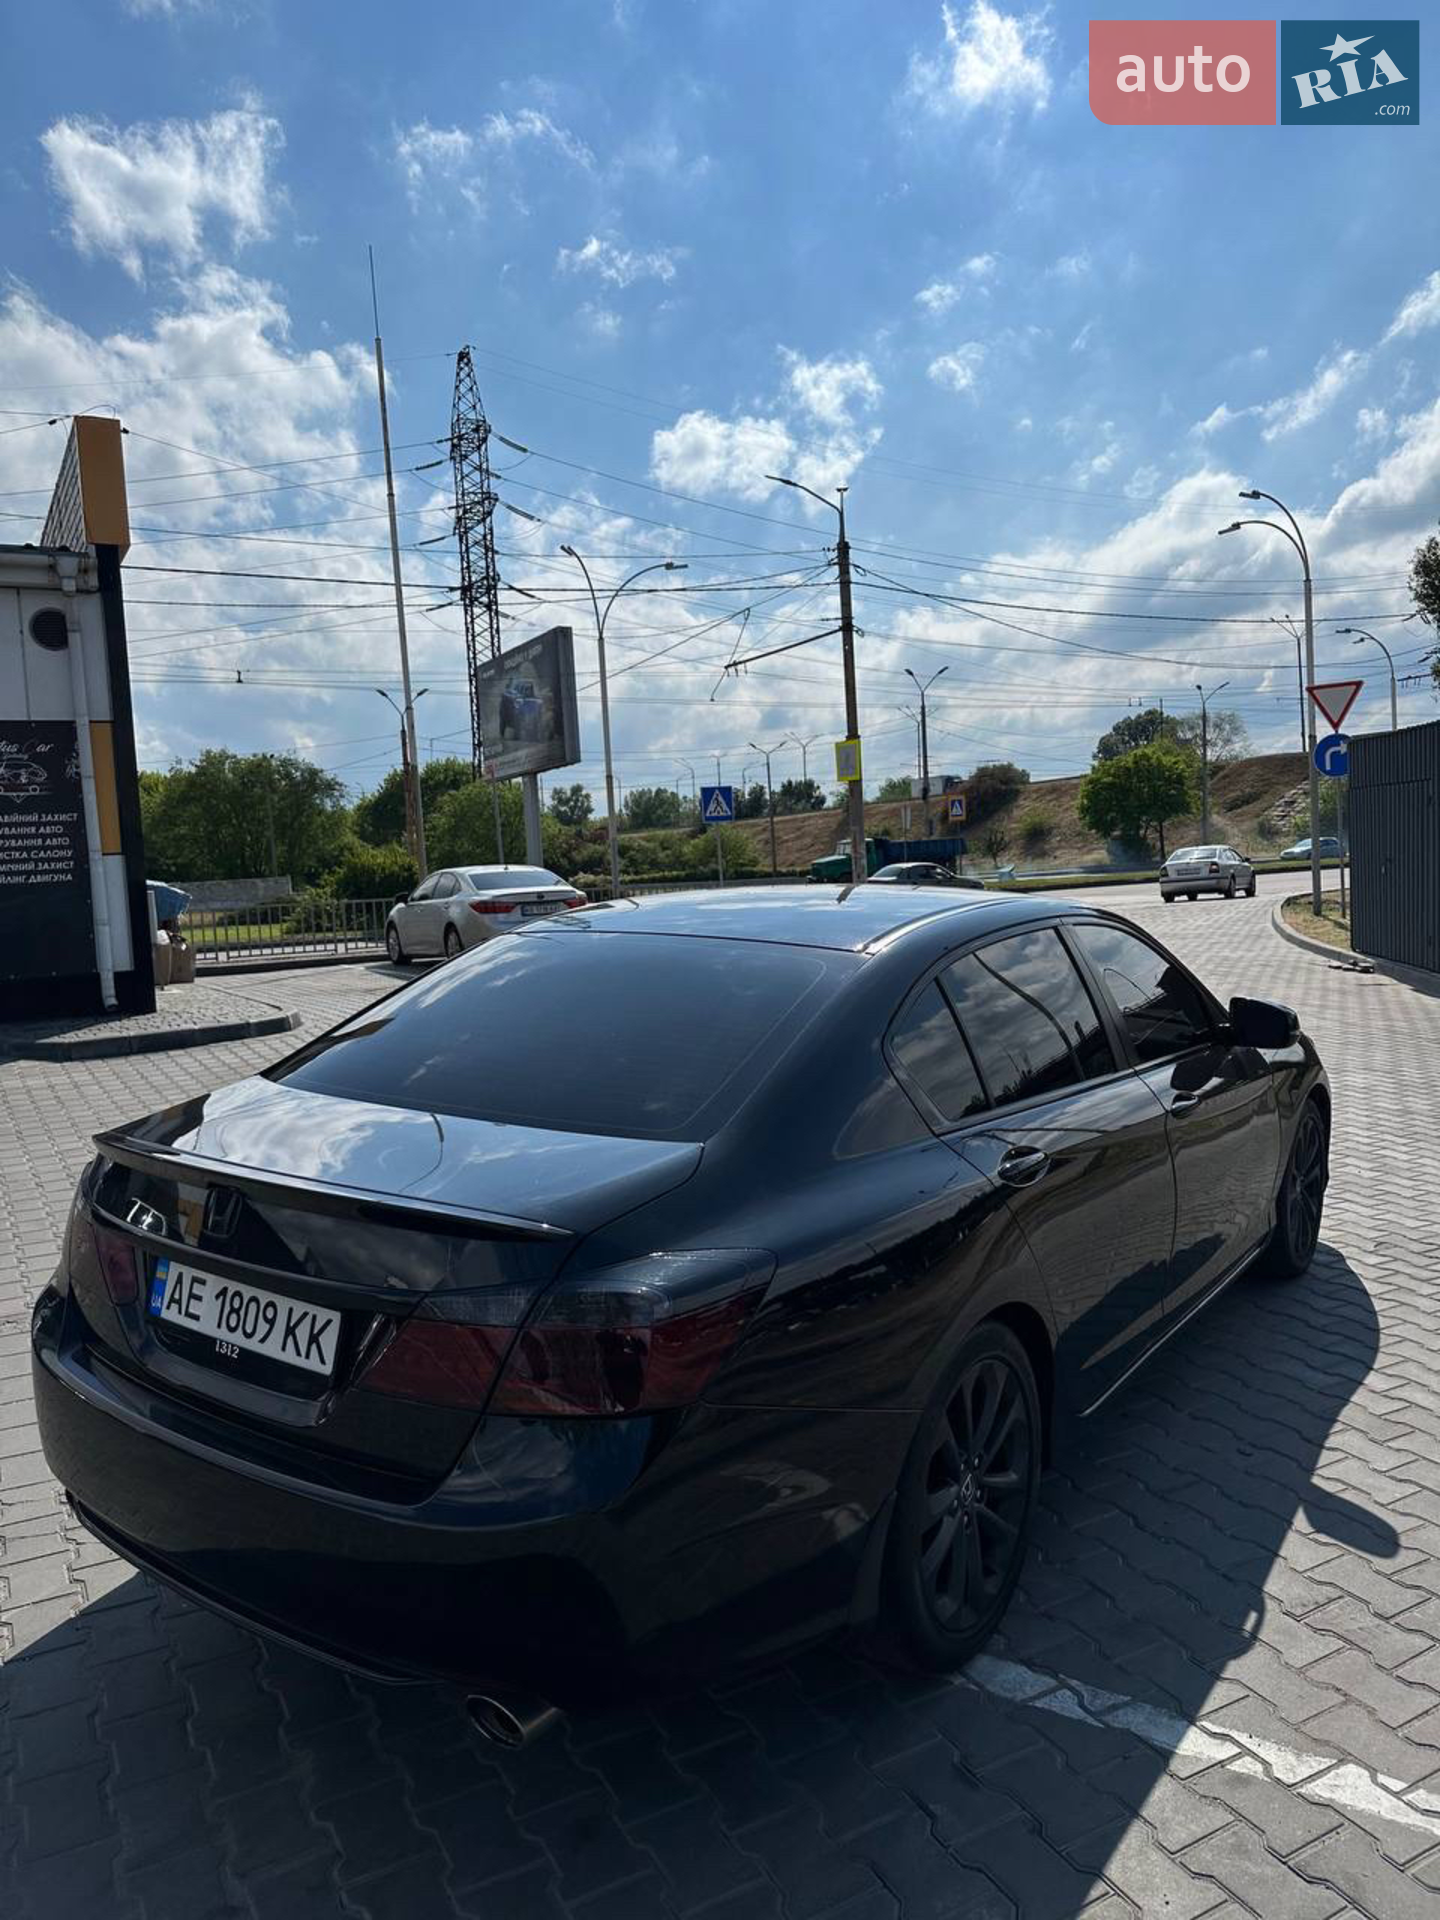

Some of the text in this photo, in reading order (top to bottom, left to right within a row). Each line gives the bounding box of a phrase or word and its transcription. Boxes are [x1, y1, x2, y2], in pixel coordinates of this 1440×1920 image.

[41, 813, 78, 822] ЗАХИСТ
[39, 825, 64, 834] АВТО
[45, 837, 70, 846] АВТО
[31, 849, 73, 859] САЛОНУ
[36, 861, 75, 871] ЗАХИСТ
[29, 873, 73, 884] ДВИГУНА
[166, 1271, 334, 1366] AE 1809 KK
[215, 1340, 240, 1359] 1312
